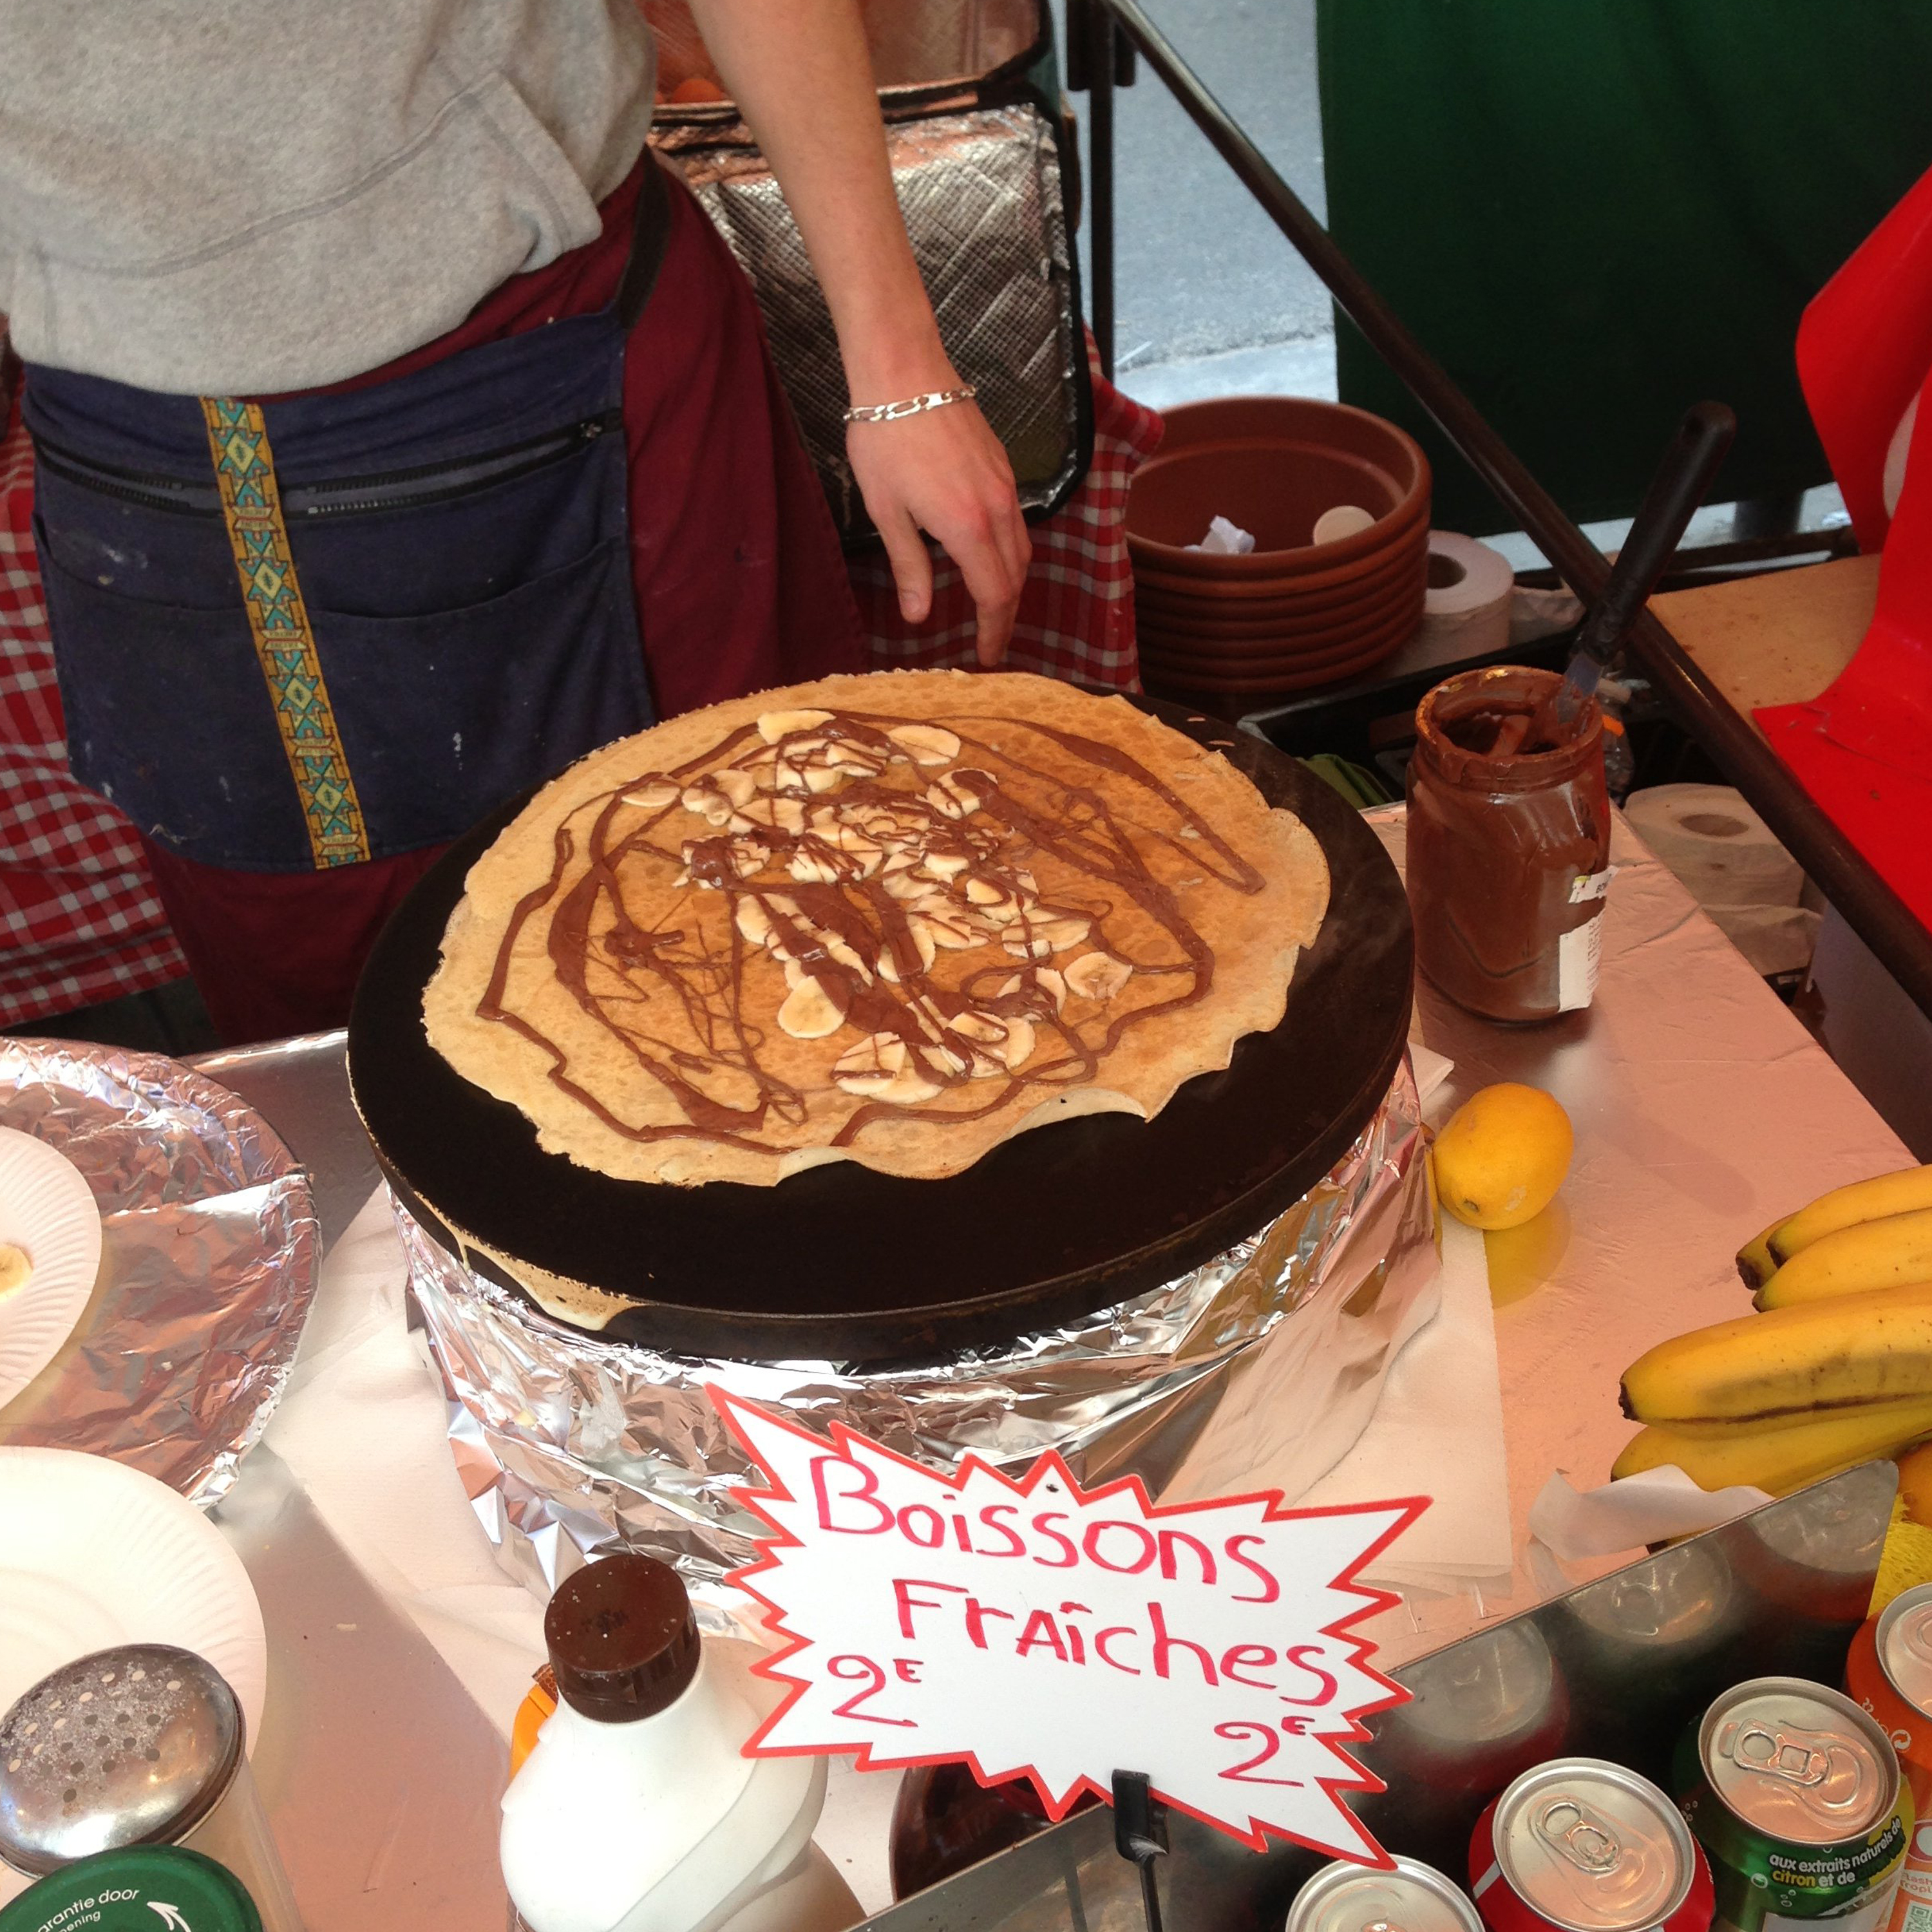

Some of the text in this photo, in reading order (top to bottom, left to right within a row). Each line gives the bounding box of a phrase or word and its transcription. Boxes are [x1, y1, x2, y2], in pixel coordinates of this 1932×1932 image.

[810, 1455, 1280, 1603] Boissons
[1770, 1819, 1901, 1873] aux extraits naturels de
[1772, 1870, 1855, 1887] citron et de
[98, 1889, 140, 1904] door
